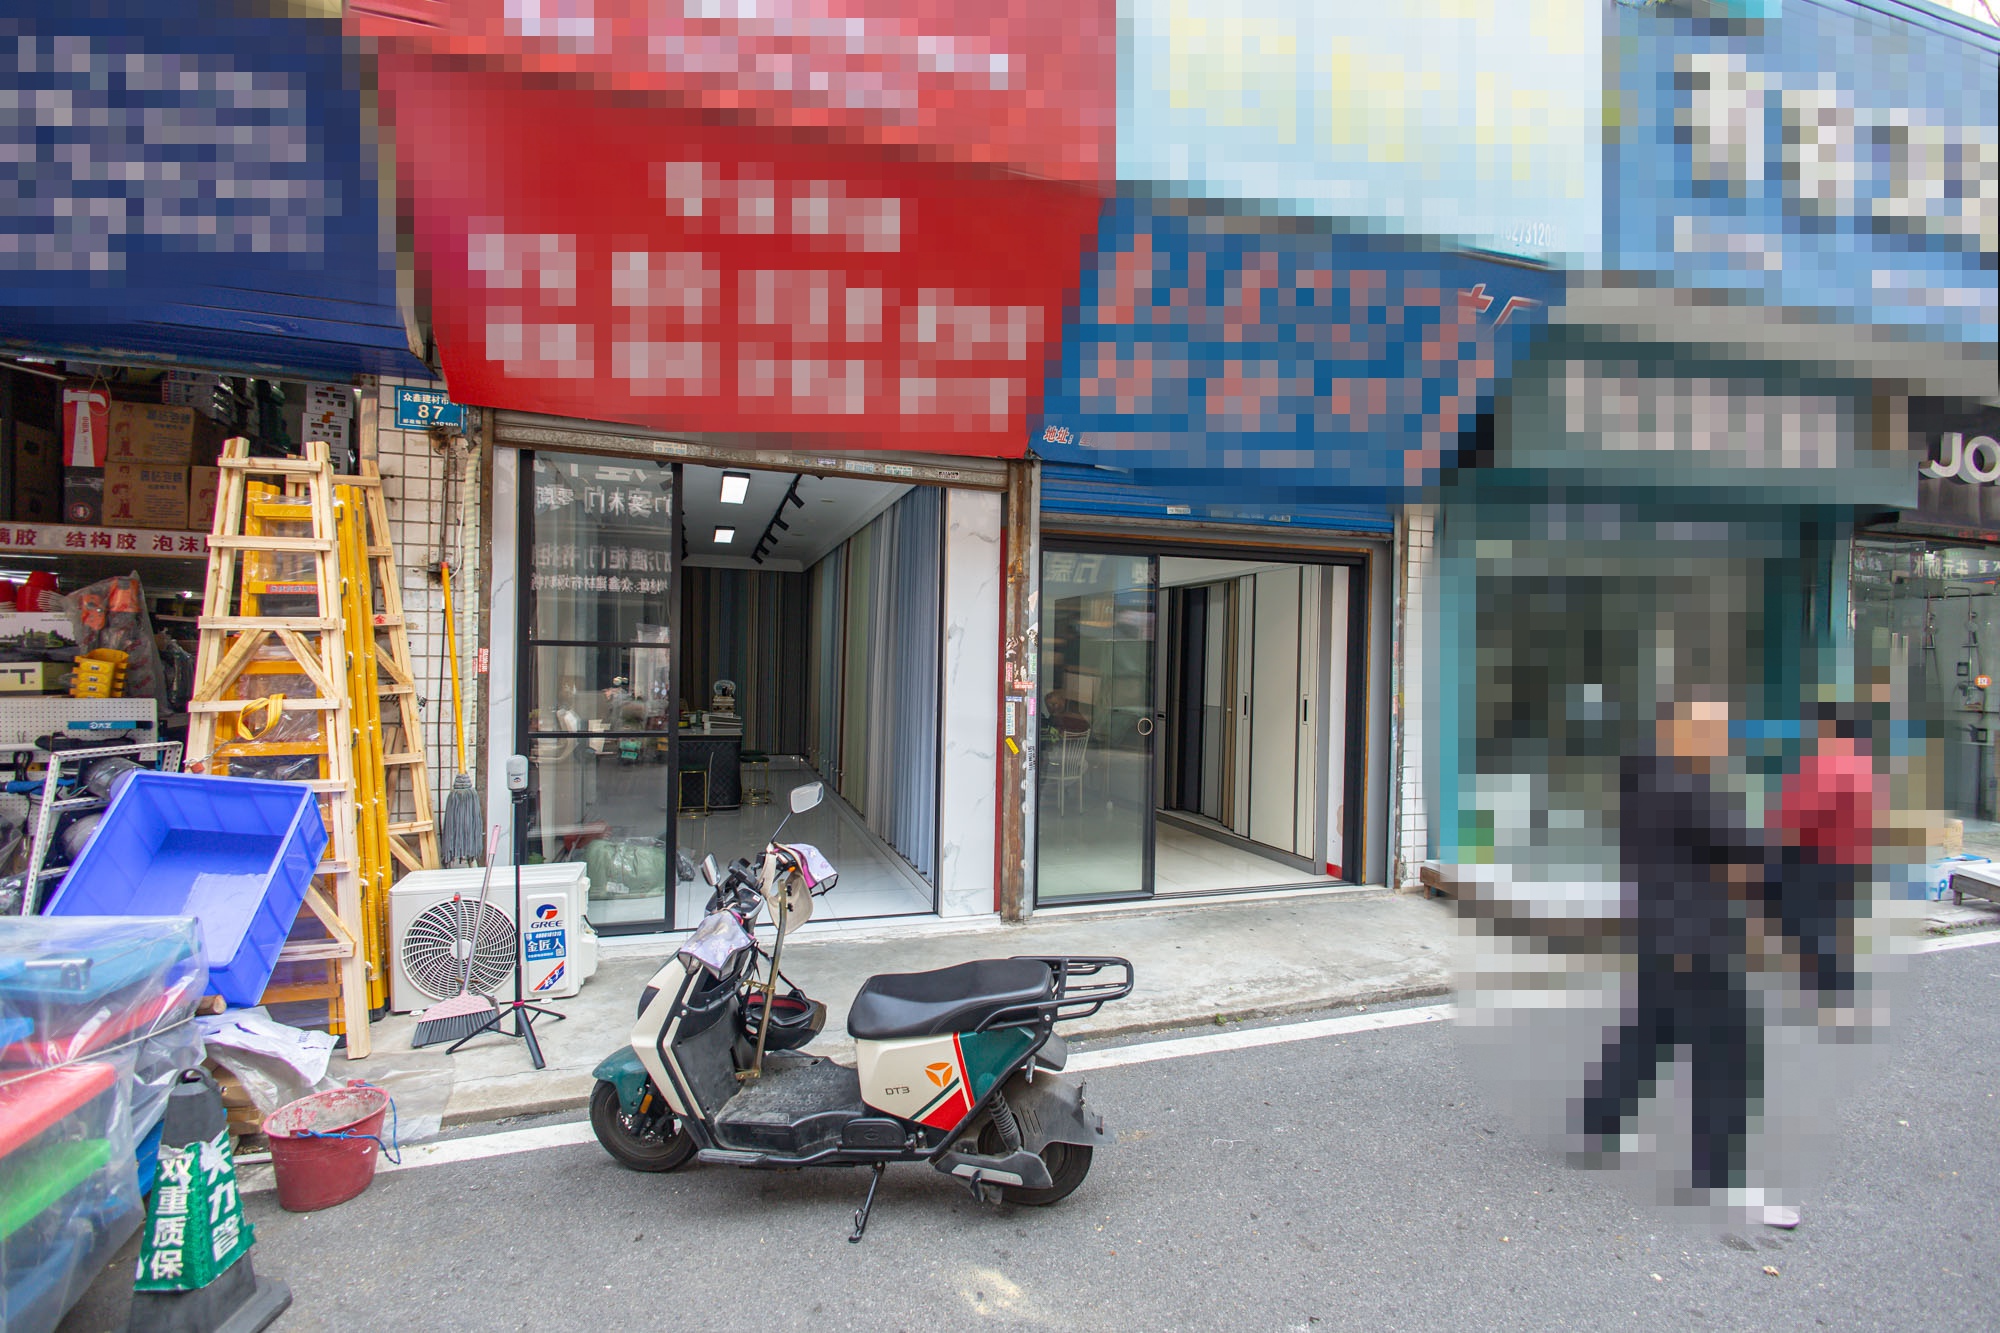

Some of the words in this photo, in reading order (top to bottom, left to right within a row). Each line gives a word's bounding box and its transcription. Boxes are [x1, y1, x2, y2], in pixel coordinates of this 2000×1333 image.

[403, 392, 459, 407] 众鑫建材市
[418, 404, 444, 420] 87
[66, 531, 137, 550] 结构胶
[152, 534, 209, 553] 泡沫
[531, 920, 563, 929] GREE
[528, 938, 564, 953] 金匠人
[885, 1086, 910, 1096] DT3
[152, 1154, 194, 1281] 双重质保
